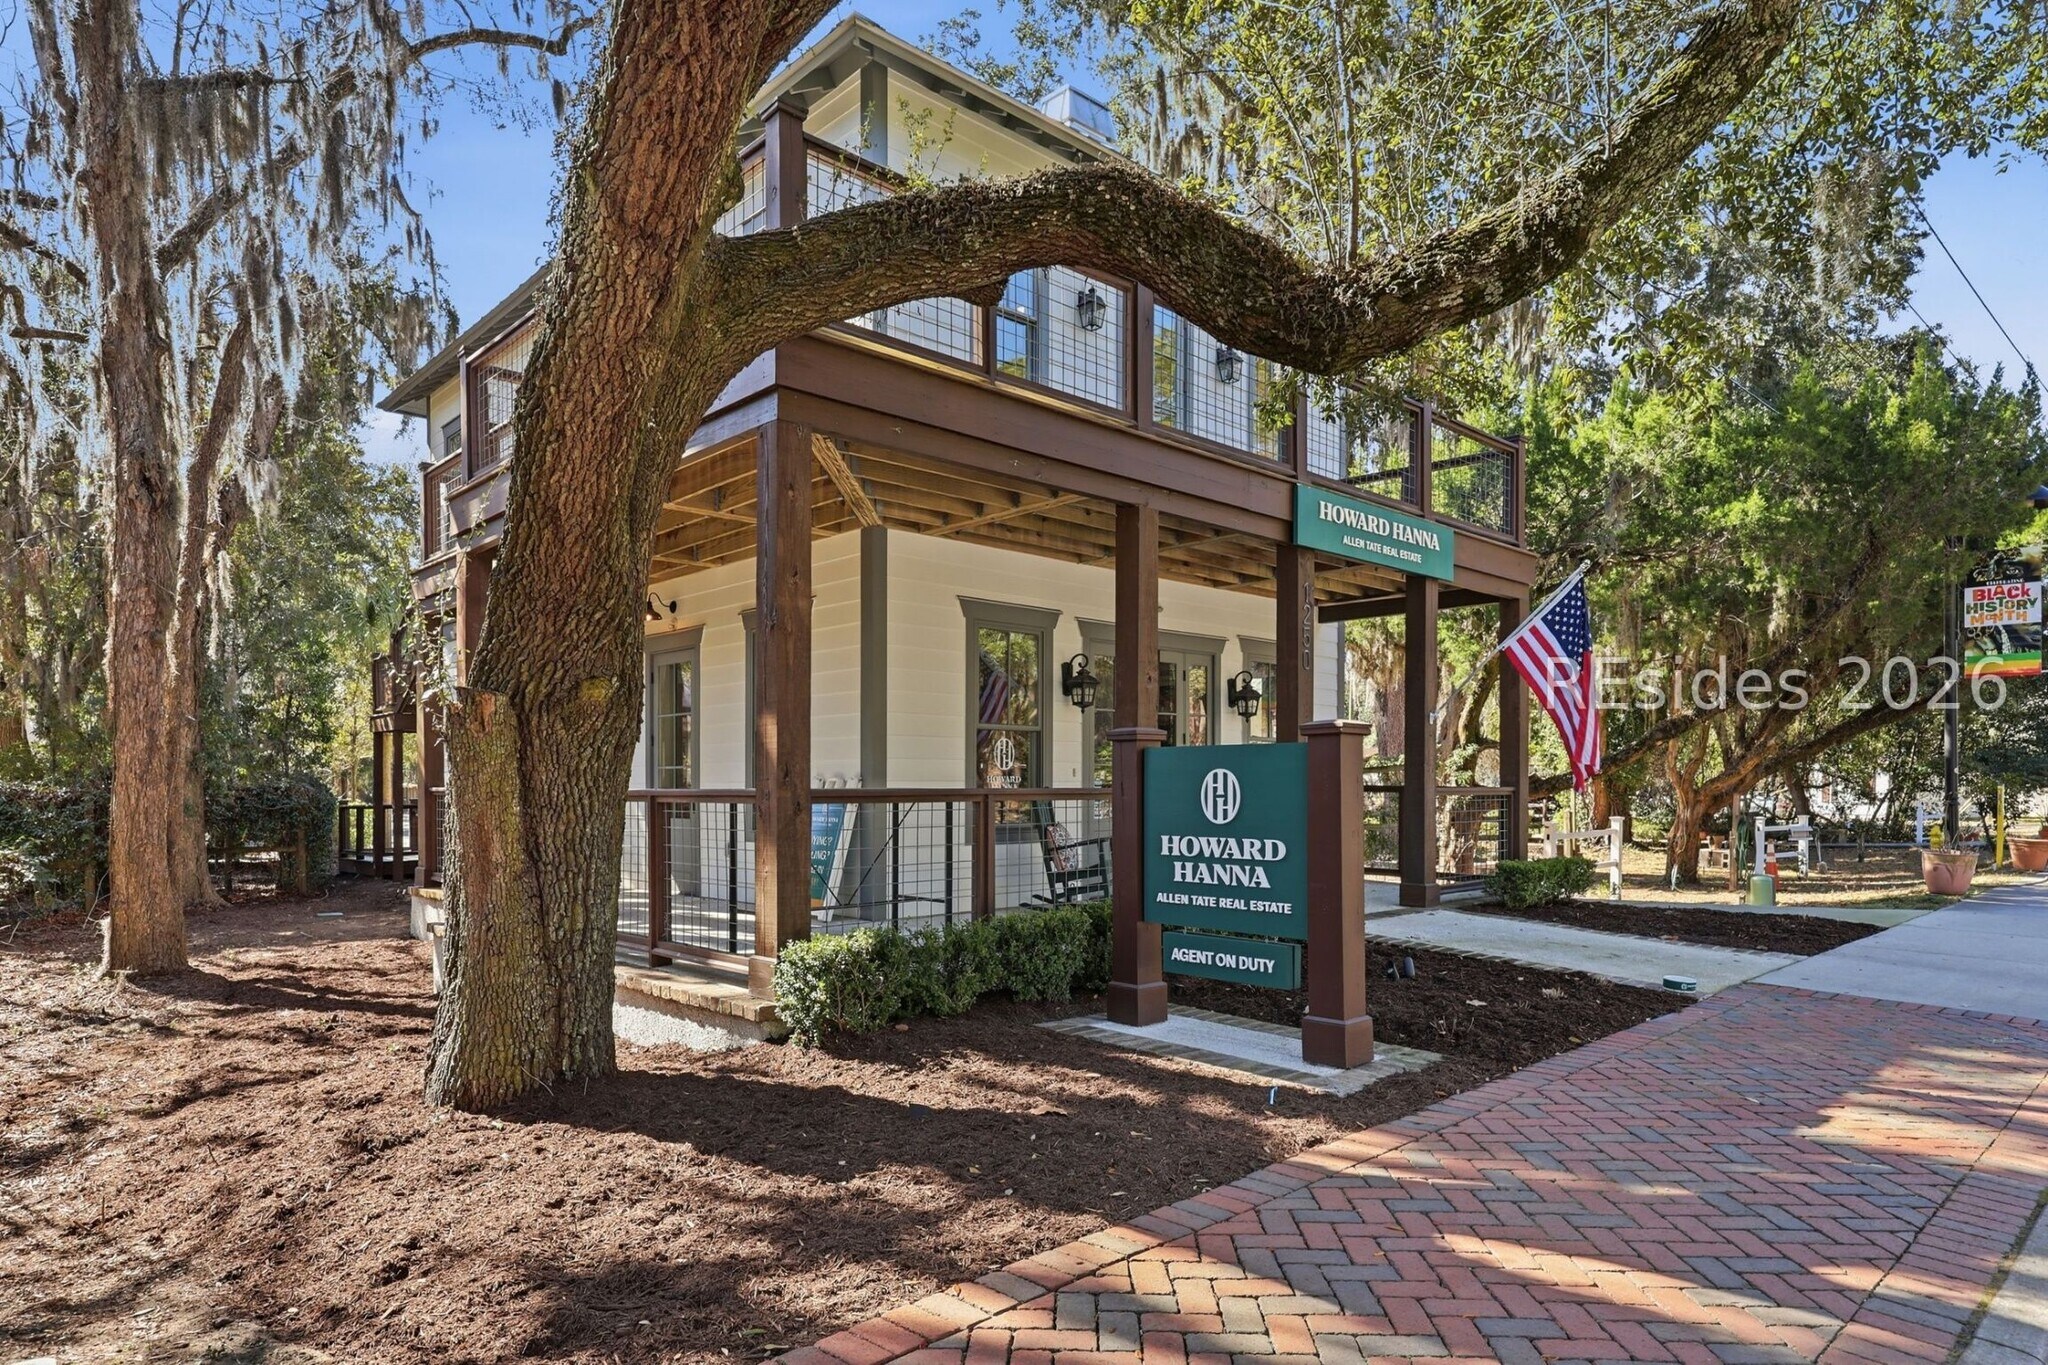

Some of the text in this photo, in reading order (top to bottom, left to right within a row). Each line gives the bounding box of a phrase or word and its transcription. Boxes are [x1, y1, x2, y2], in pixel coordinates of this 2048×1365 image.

[1318, 500, 1440, 551] HOWARD HANNA
[1342, 535, 1422, 564] ALLEN TATE REAL ESTATE
[1966, 596, 2038, 614] HISTORY
[1970, 608, 2028, 625] MONTH
[986, 775, 1021, 783] HOWARD
[812, 836, 833, 846] YING?
[1160, 835, 1287, 862] HOWARD
[1173, 861, 1271, 889] HANNA
[1156, 892, 1292, 915] ALLEN TATE REAL ESTATE
[1171, 947, 1275, 974] AGENT ON DUTY
